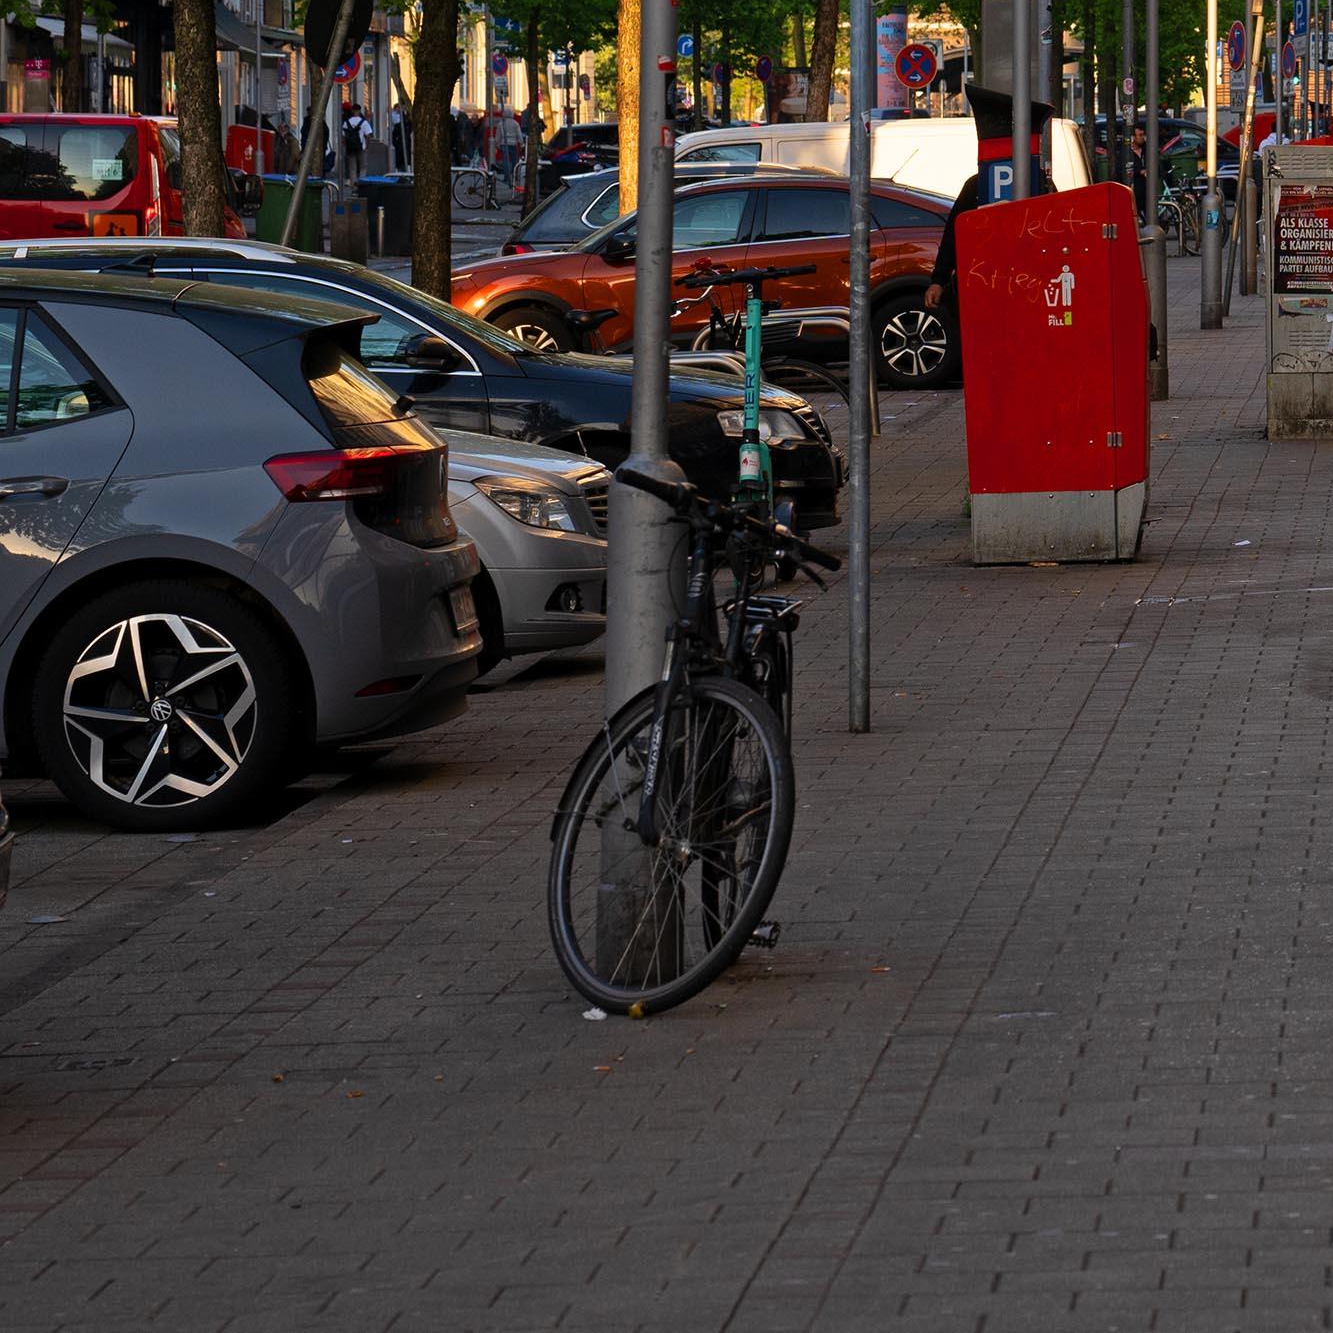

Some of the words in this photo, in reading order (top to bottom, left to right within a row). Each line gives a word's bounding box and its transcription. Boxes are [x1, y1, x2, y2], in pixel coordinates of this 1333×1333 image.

[993, 165, 1013, 199] P
[1280, 218, 1296, 229] ALS
[1298, 218, 1329, 229] KLASSE
[1280, 240, 1287, 251] &
[1279, 264, 1303, 274] PARTEI
[1048, 319, 1065, 327] FILL
